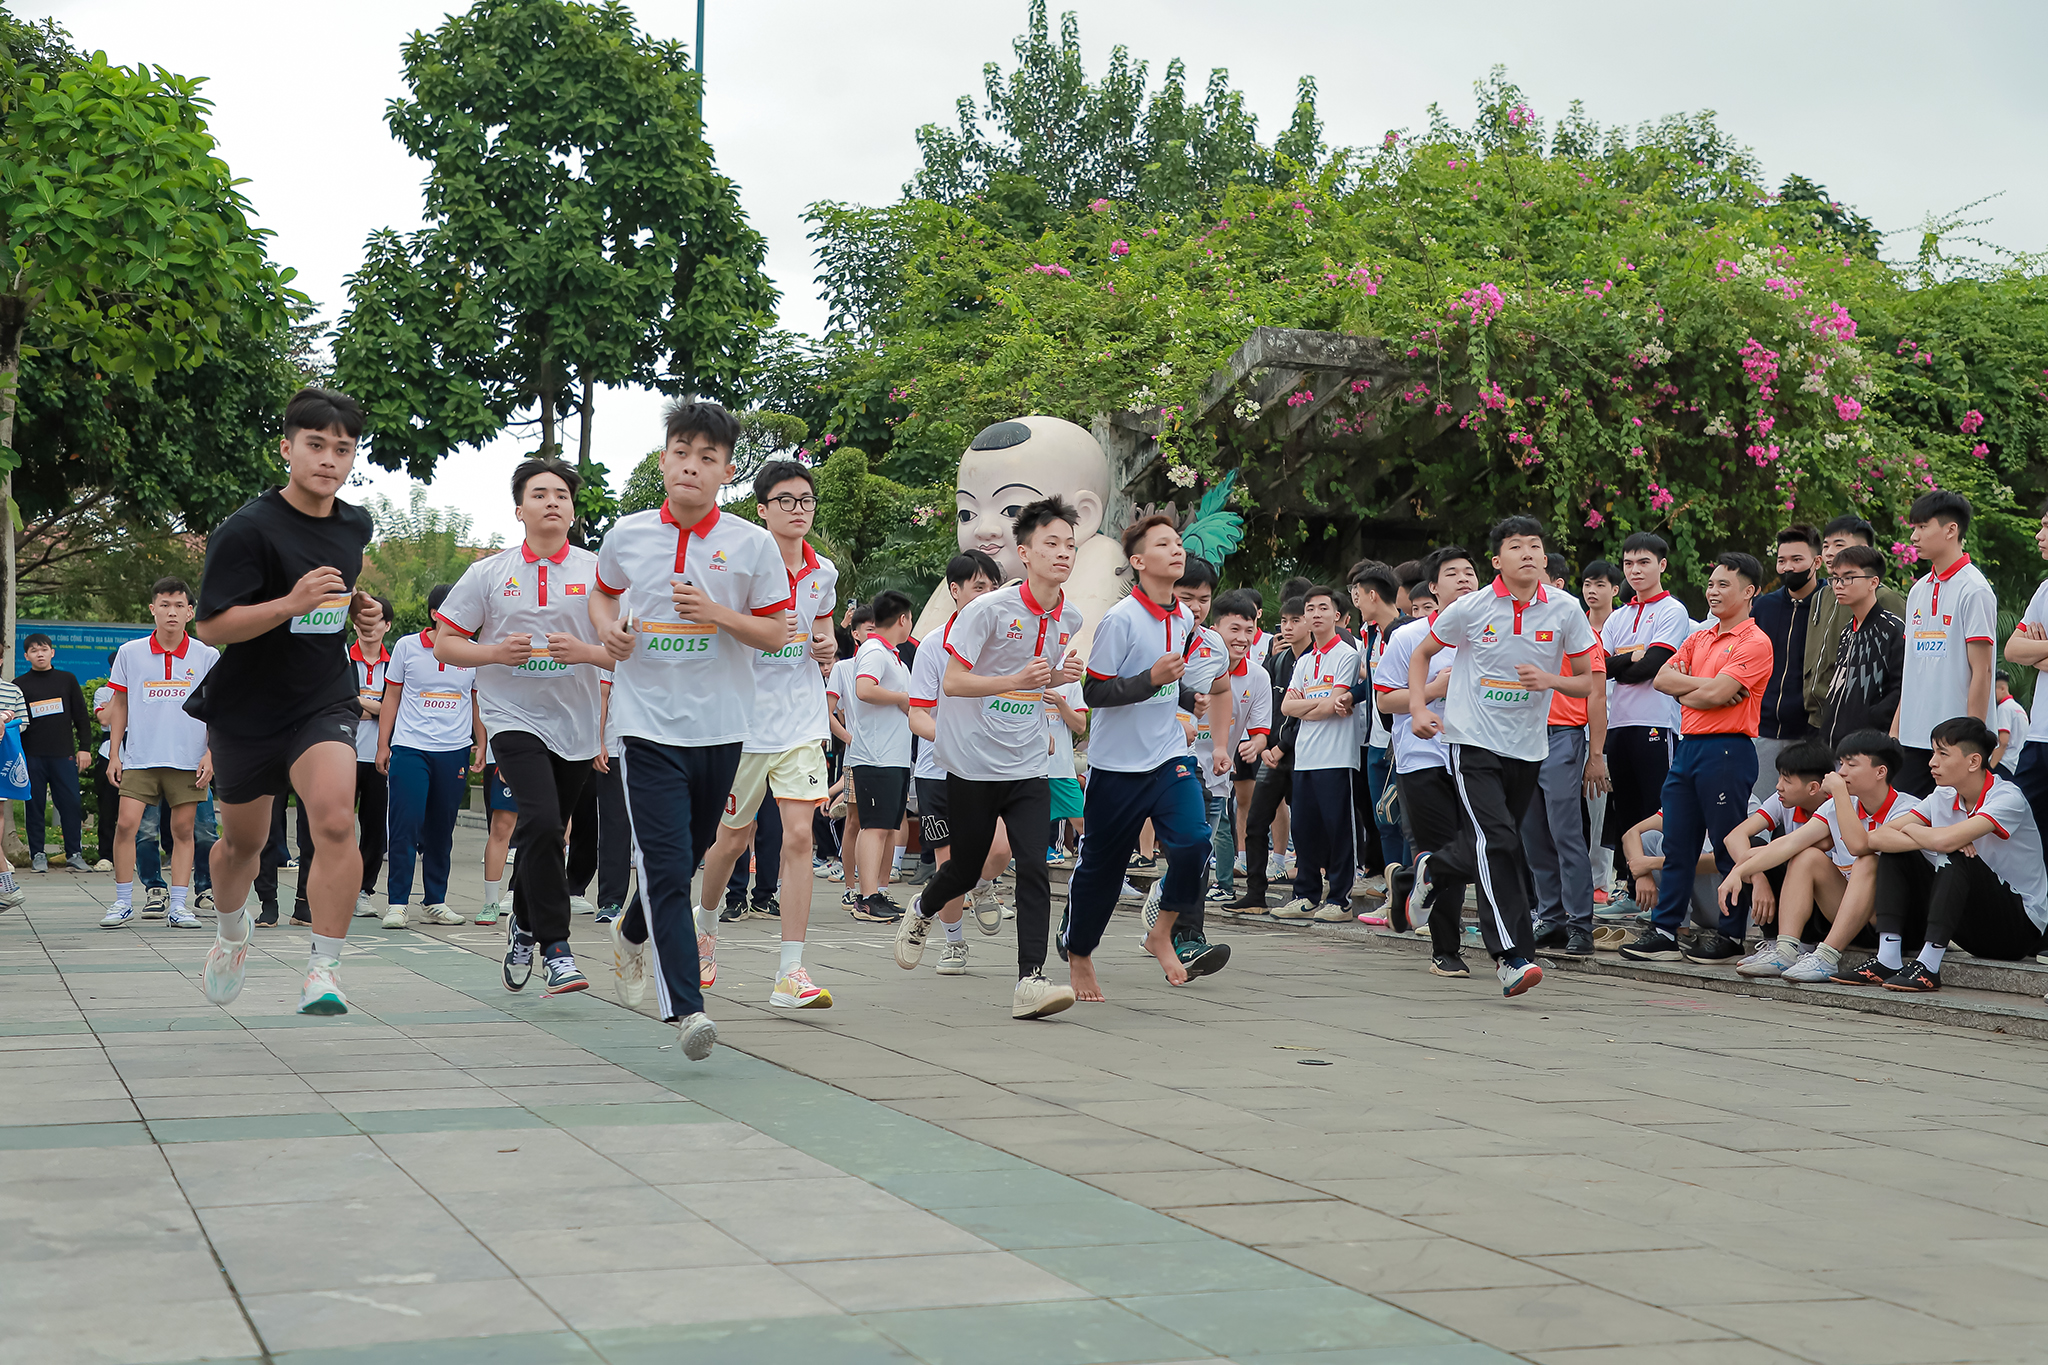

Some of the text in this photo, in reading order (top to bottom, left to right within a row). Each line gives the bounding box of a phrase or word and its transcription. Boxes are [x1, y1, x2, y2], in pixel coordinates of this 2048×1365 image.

[647, 637, 710, 652] A0015
[1916, 641, 1946, 651] W027
[148, 689, 186, 698] B0036
[1484, 690, 1530, 702] A0014
[423, 700, 457, 710] B0032
[988, 699, 1035, 715] A0002
